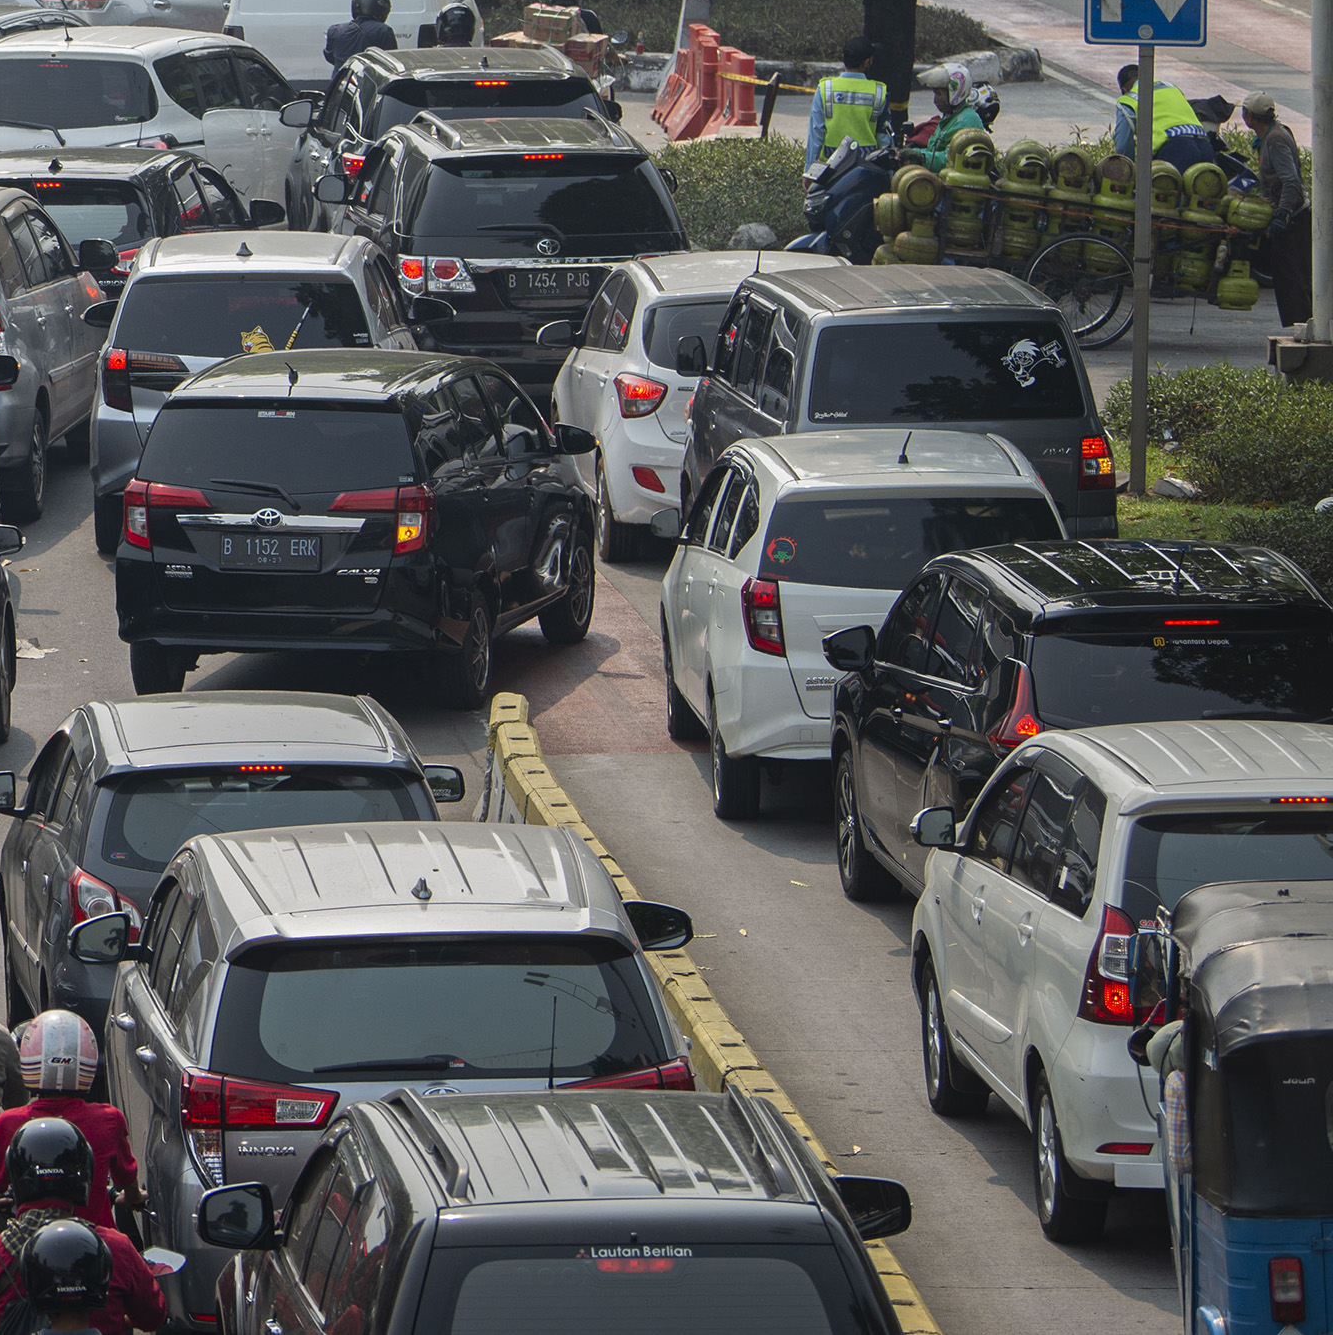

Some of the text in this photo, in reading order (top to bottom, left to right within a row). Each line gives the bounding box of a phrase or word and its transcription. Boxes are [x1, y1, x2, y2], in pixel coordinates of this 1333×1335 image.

[509, 272, 590, 288] B 1454 PJG
[223, 538, 317, 556] B 1152 ERK
[50, 1056, 72, 1064] GM
[237, 1145, 297, 1157] INNOVA
[590, 1245, 693, 1258] Lautan Berlian
[56, 1285, 87, 1293] HONDA
